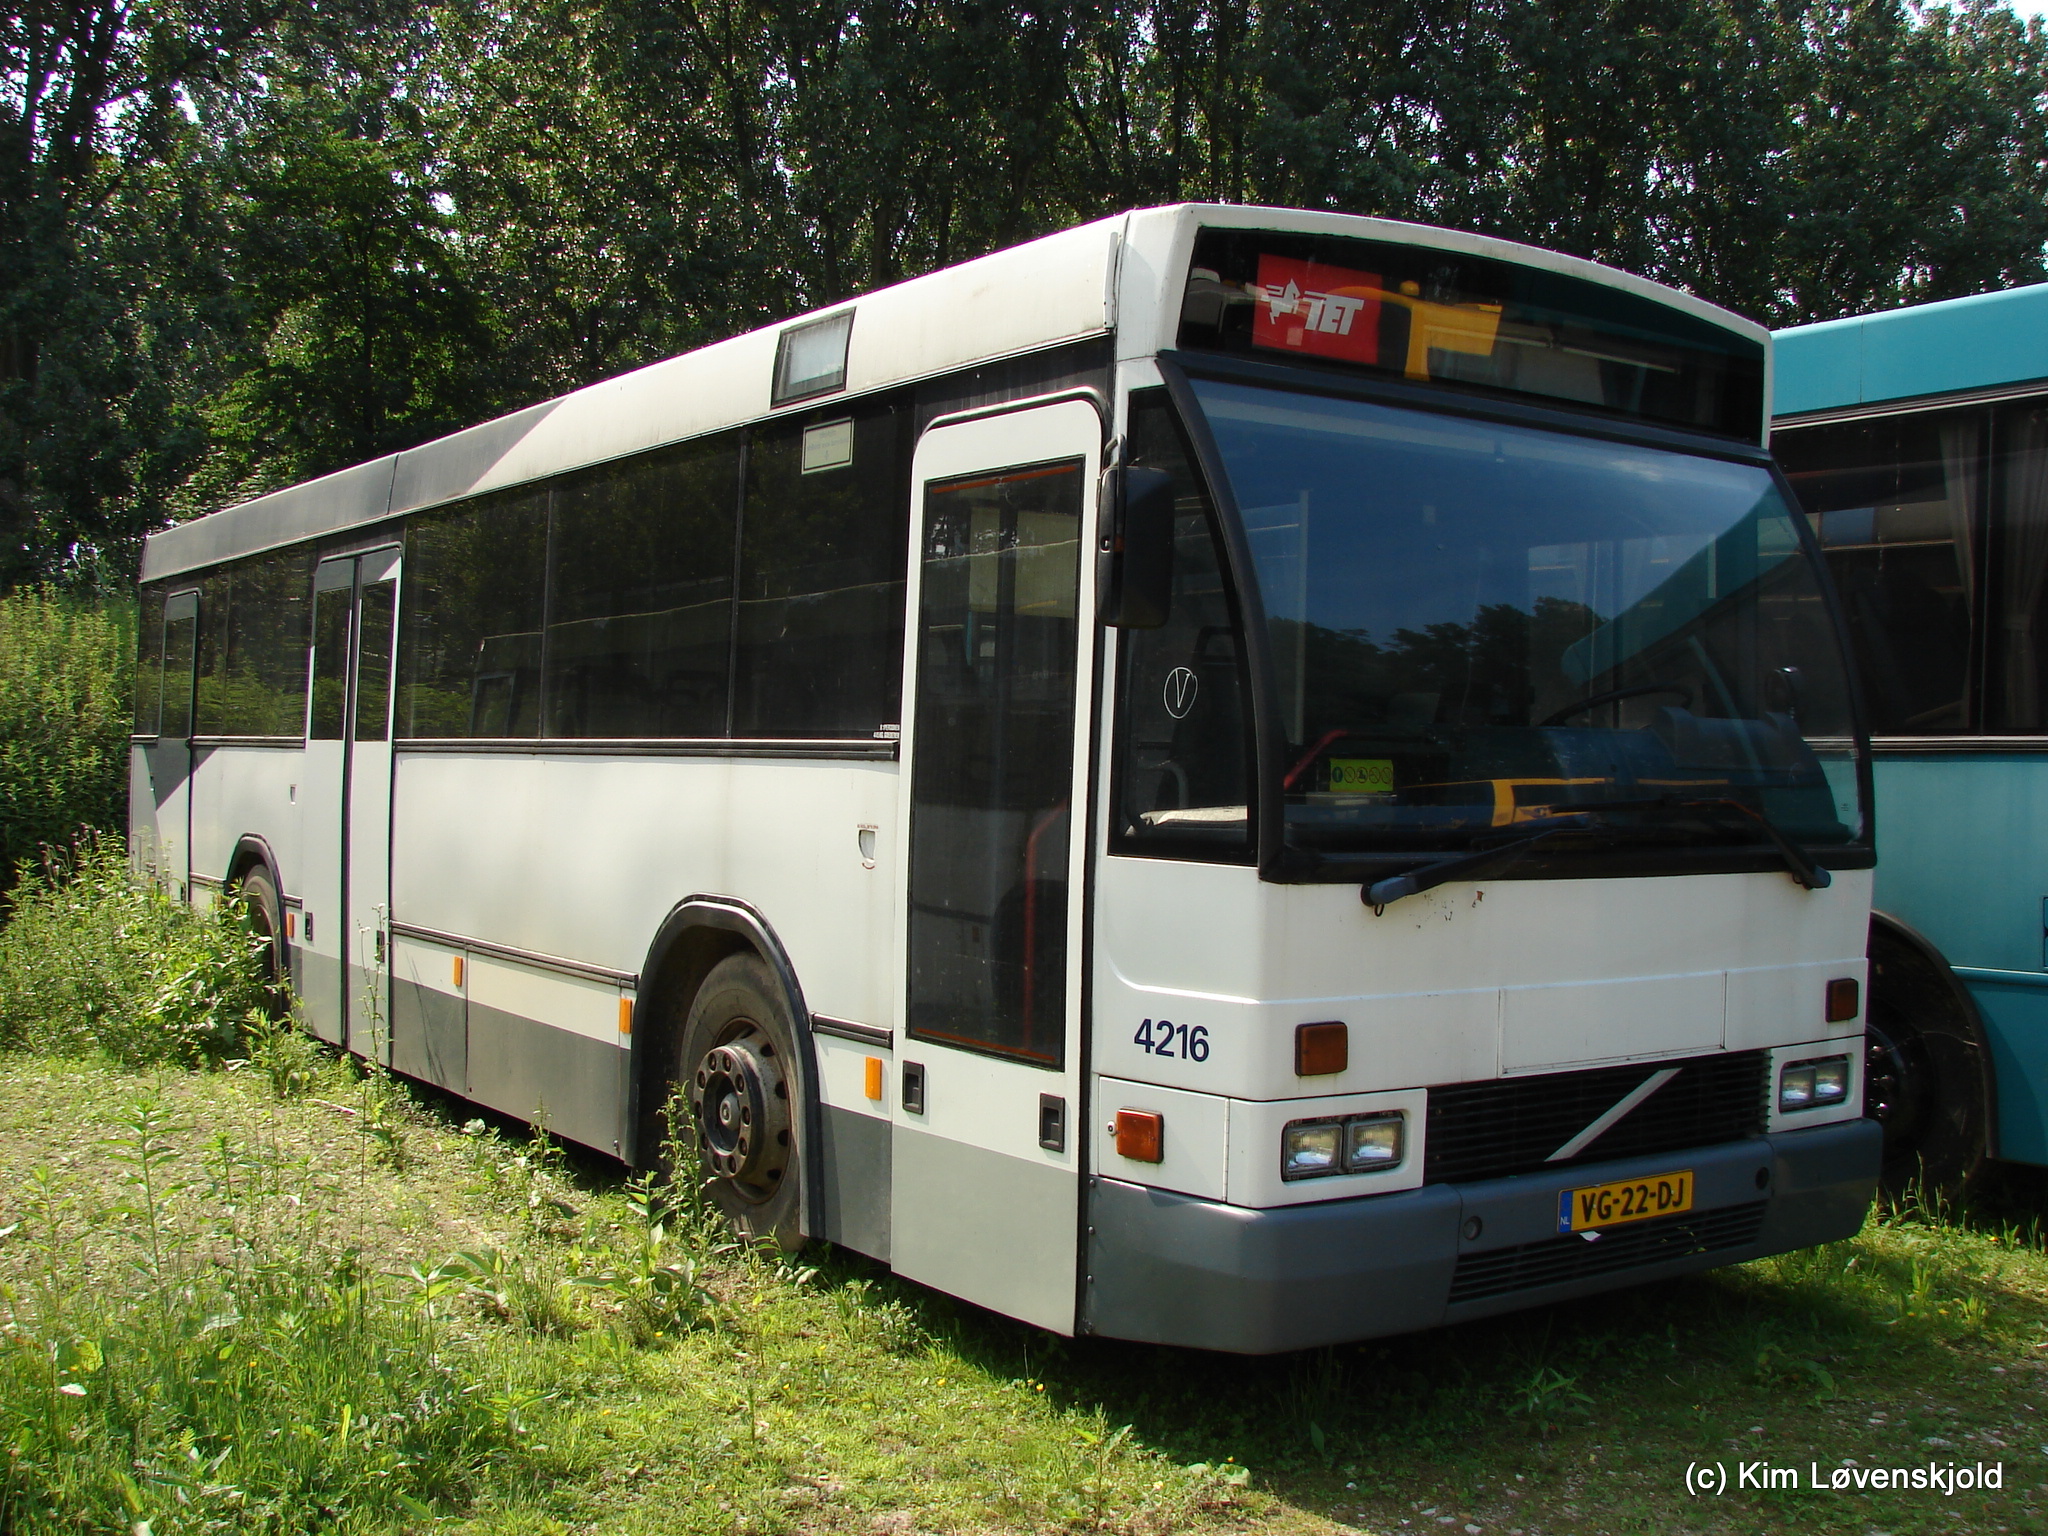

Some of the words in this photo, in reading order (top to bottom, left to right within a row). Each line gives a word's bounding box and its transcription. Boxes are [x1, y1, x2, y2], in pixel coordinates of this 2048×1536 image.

[1303, 290, 1364, 335] TET
[1134, 1018, 1210, 1063] 4216
[1560, 1216, 1570, 1226] NL
[1581, 1177, 1684, 1223] VG-22-DJ
